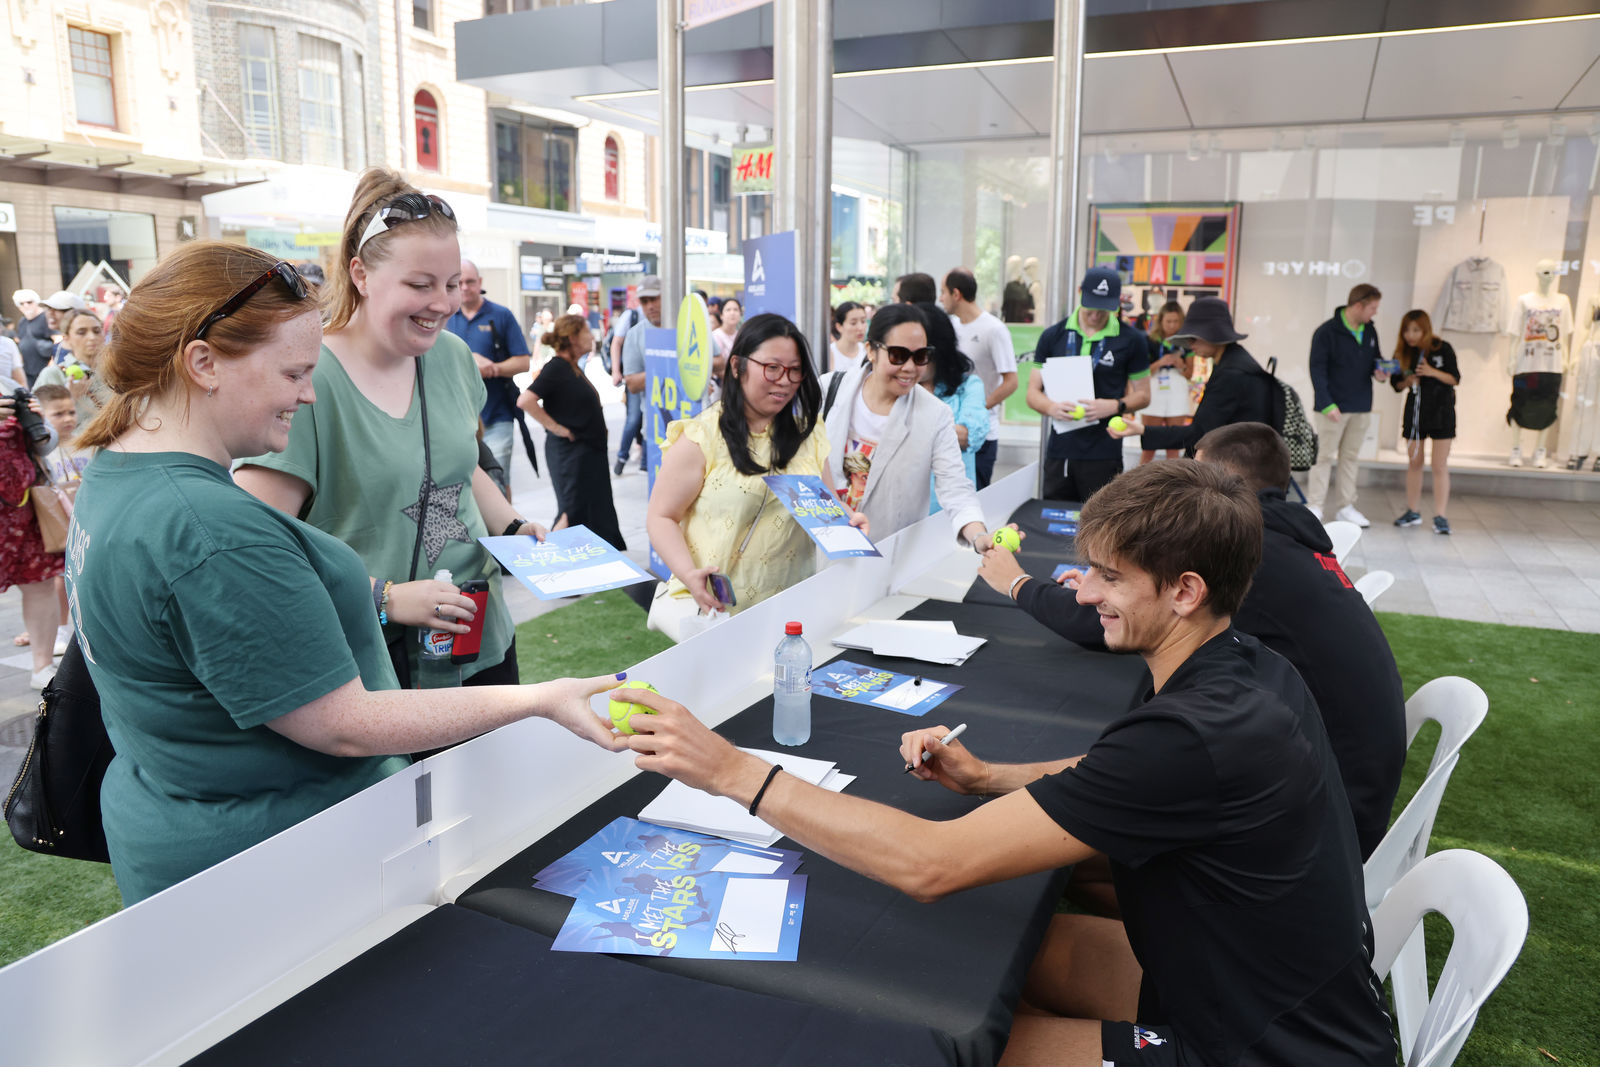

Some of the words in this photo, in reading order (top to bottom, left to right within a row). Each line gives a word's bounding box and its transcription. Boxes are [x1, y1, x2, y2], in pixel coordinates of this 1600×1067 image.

[736, 152, 773, 181] H&M
[794, 505, 845, 518] STARS
[512, 546, 607, 567] STARS
[842, 672, 894, 698] STARS
[650, 878, 674, 901] THE
[638, 902, 664, 930] MET
[650, 875, 697, 949] STARS
